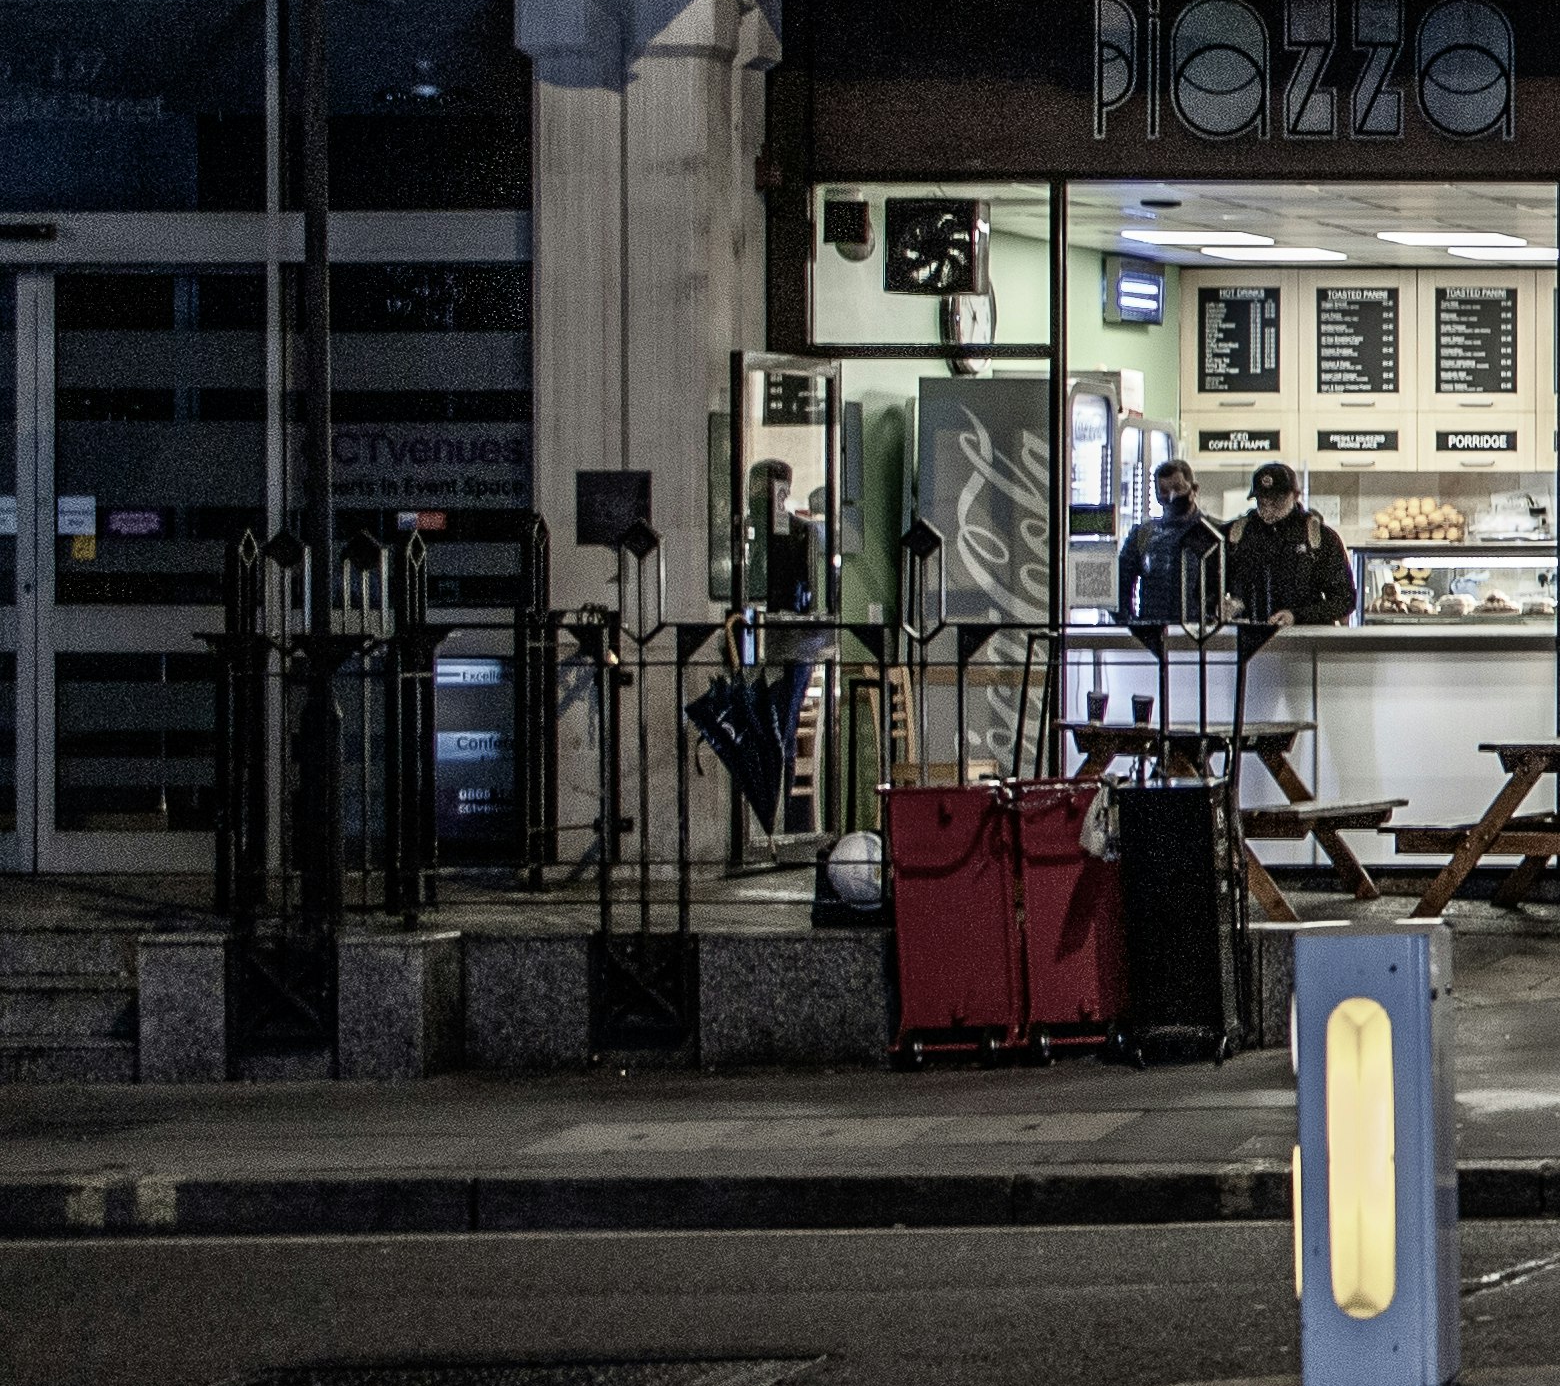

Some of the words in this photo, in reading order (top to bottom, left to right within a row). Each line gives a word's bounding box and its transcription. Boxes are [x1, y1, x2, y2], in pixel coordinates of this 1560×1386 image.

[1327, 290, 1362, 299] TOASTED
[1446, 289, 1481, 299] TOASTED
[1208, 440, 1239, 449] COFFEE
[1448, 435, 1507, 449] PORRIDGE
[403, 477, 457, 493] Event
[465, 477, 524, 498] Space
